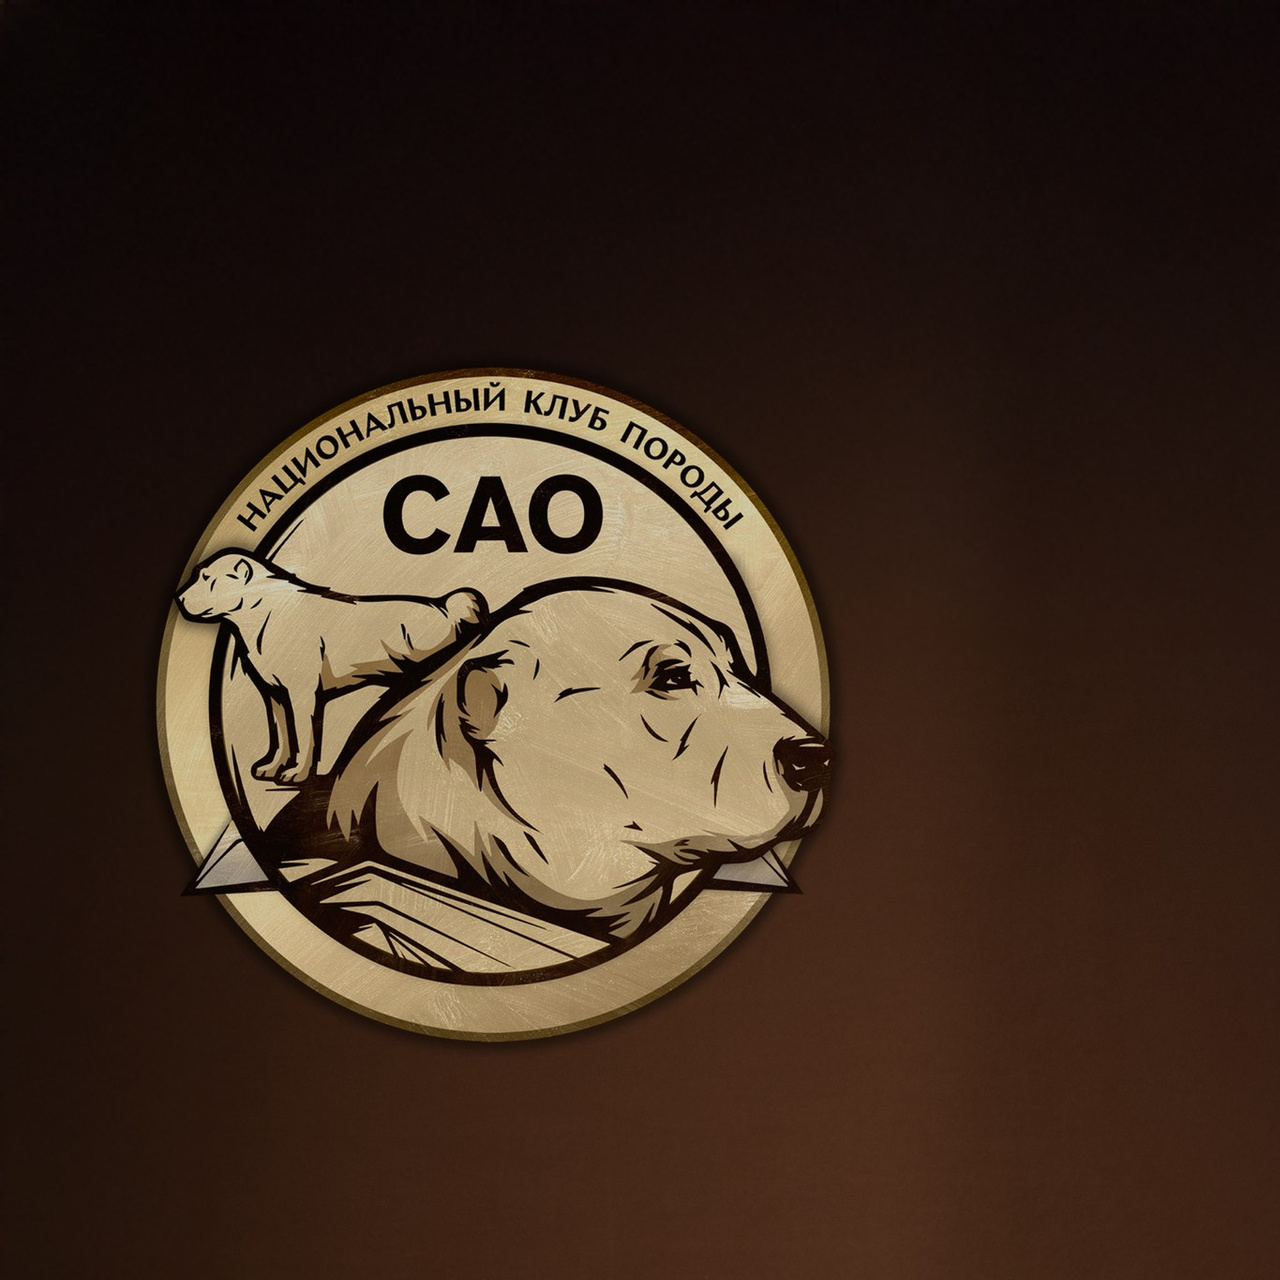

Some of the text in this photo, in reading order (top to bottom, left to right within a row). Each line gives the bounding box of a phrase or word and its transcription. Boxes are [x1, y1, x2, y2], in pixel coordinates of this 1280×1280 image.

[237, 382, 745, 533] НАЦИОНАЛЬНЫЙ КЛУБ ПОРОДЫ
[382, 473, 604, 555] САО
